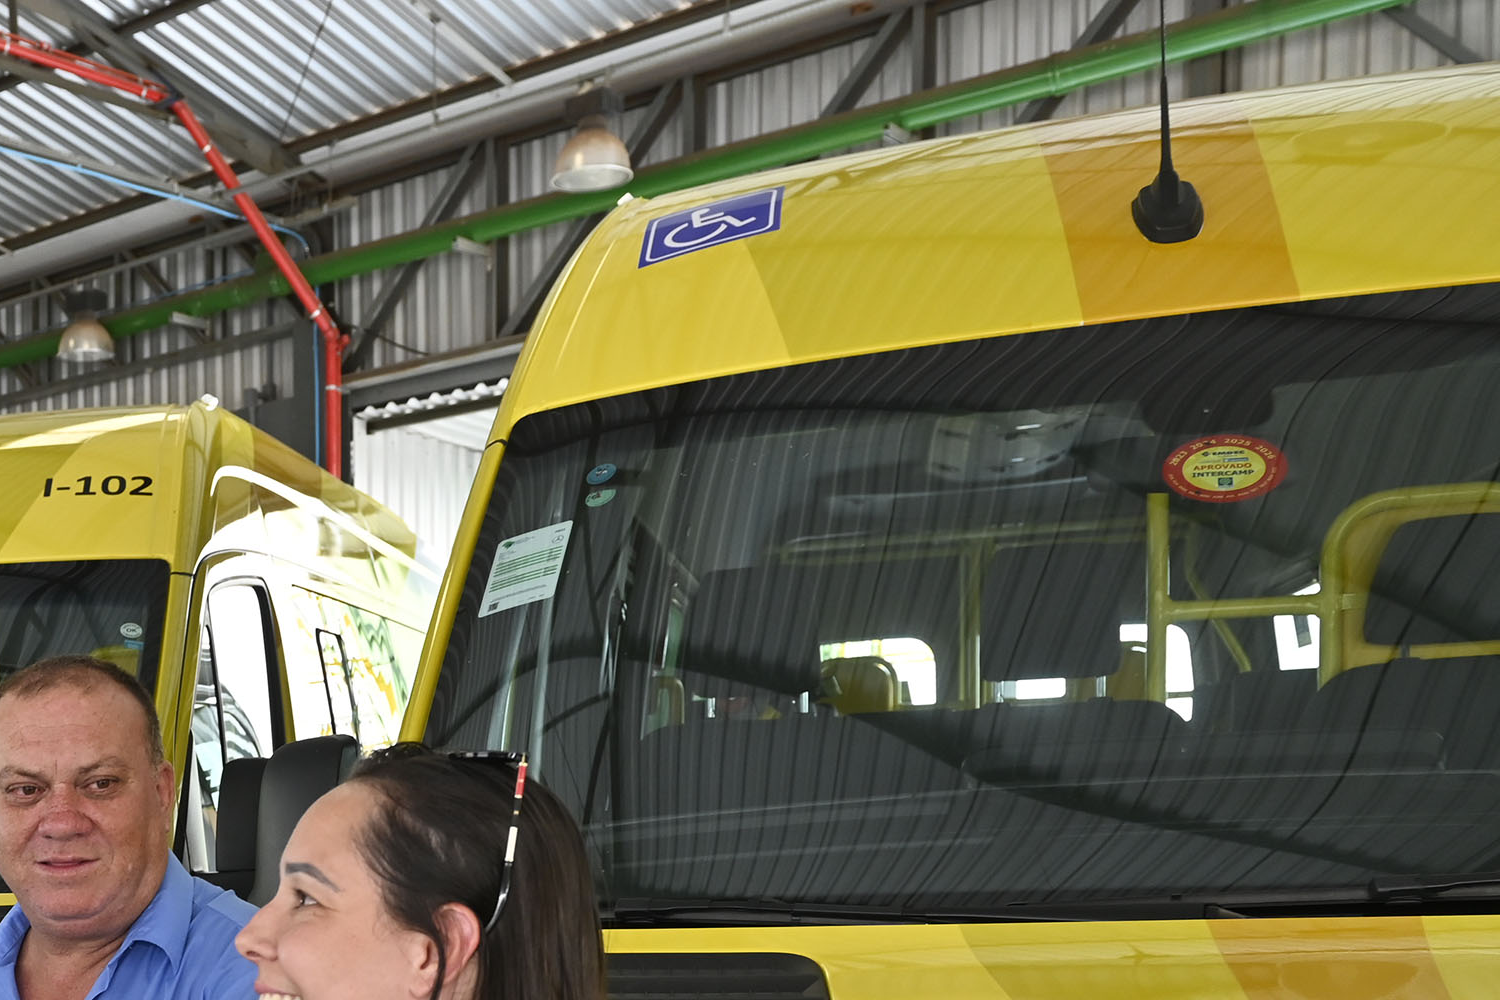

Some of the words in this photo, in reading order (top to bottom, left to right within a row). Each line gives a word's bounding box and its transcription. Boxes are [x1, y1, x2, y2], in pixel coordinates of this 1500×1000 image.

[1224, 438, 1252, 447] 2025
[1193, 462, 1252, 471] APROVADO
[1192, 469, 1255, 478] INTERCAMP
[43, 475, 154, 498] I-102
